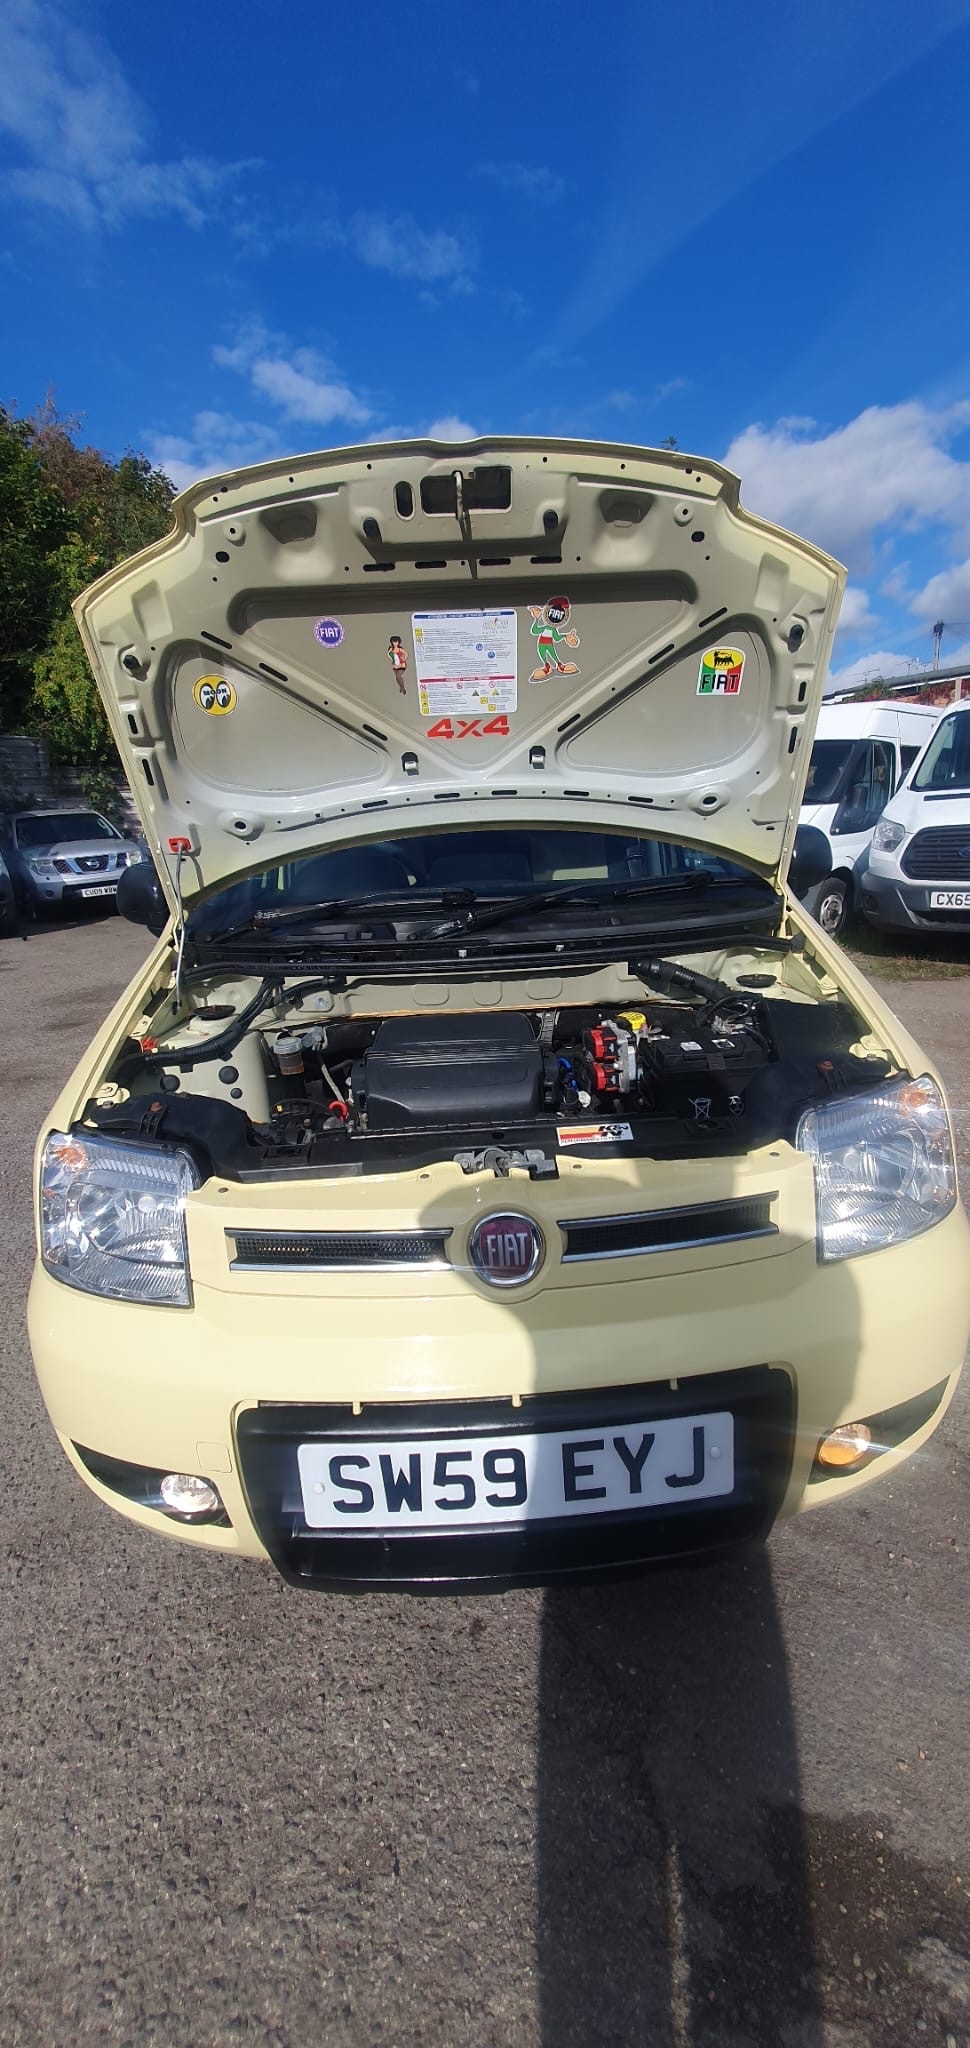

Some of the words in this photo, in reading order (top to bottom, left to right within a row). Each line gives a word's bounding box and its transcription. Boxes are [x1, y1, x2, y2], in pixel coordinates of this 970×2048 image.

[549, 608, 565, 620] FIAT
[319, 627, 339, 638] FIAT
[701, 673, 739, 690] FIAT
[203, 688, 227, 696] MOON
[486, 1232, 528, 1267] FIAT
[328, 1447, 528, 1514] SW59
[561, 1426, 705, 1502] EYJ
